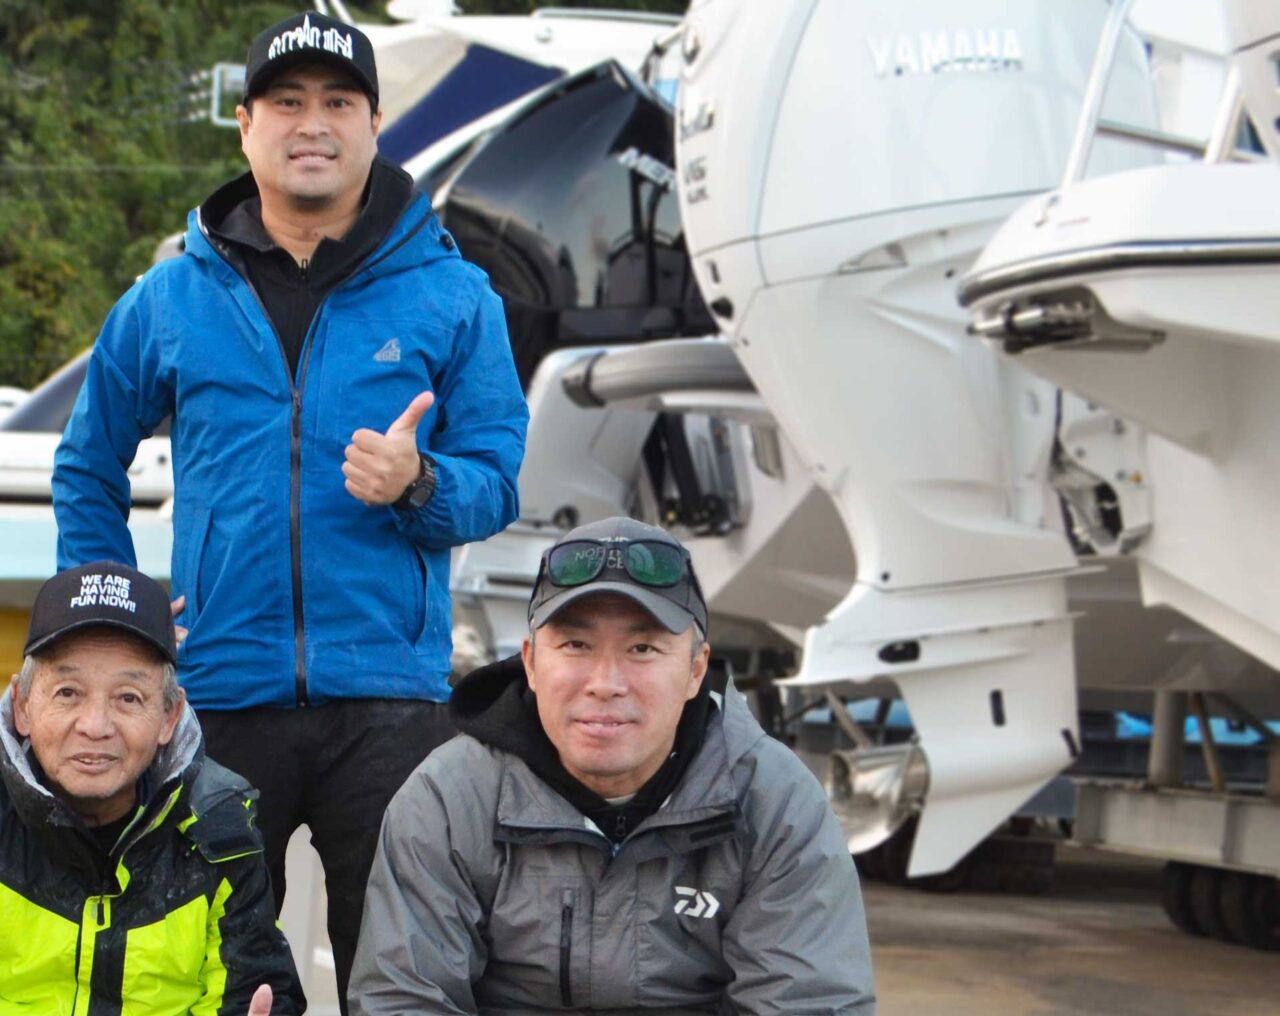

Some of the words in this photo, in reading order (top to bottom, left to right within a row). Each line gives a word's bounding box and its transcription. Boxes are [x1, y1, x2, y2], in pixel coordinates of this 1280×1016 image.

[866, 28, 1024, 79] YAMAHA
[81, 573, 102, 586] WE
[103, 573, 131, 590] ARE
[80, 583, 129, 600] HAVING
[70, 594, 97, 609] FUN
[98, 594, 137, 614] NOW!!
